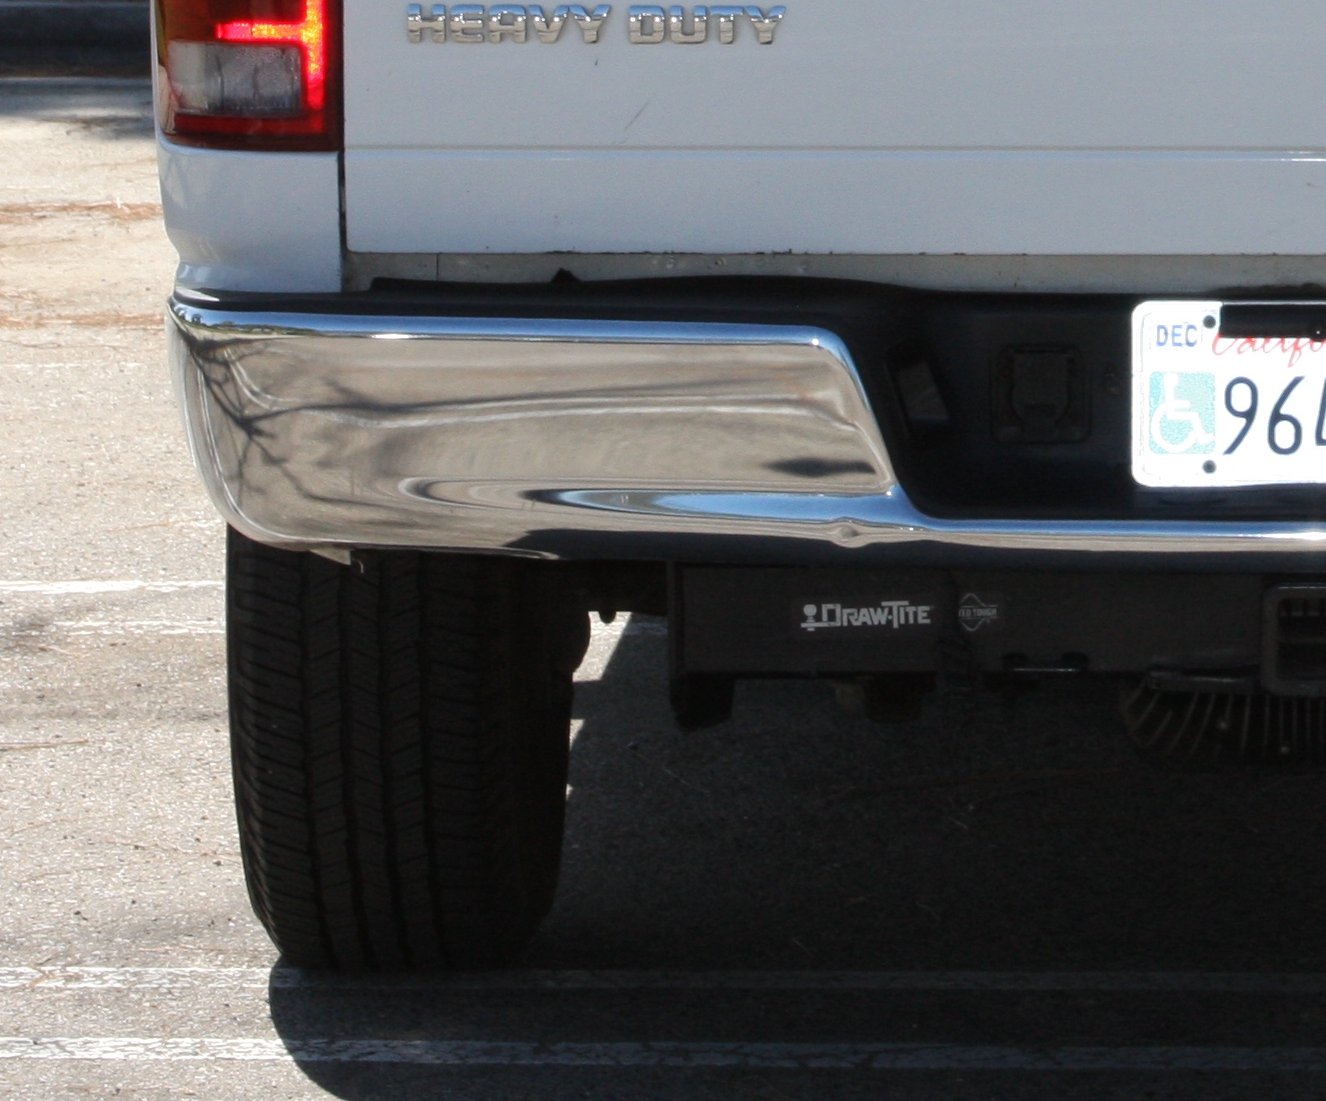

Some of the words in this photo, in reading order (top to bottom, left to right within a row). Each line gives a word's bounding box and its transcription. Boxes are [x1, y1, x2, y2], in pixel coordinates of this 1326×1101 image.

[406, 3, 611, 44] HEAVY
[628, 4, 788, 45] DUTY
[1155, 324, 1198, 348] DEC
